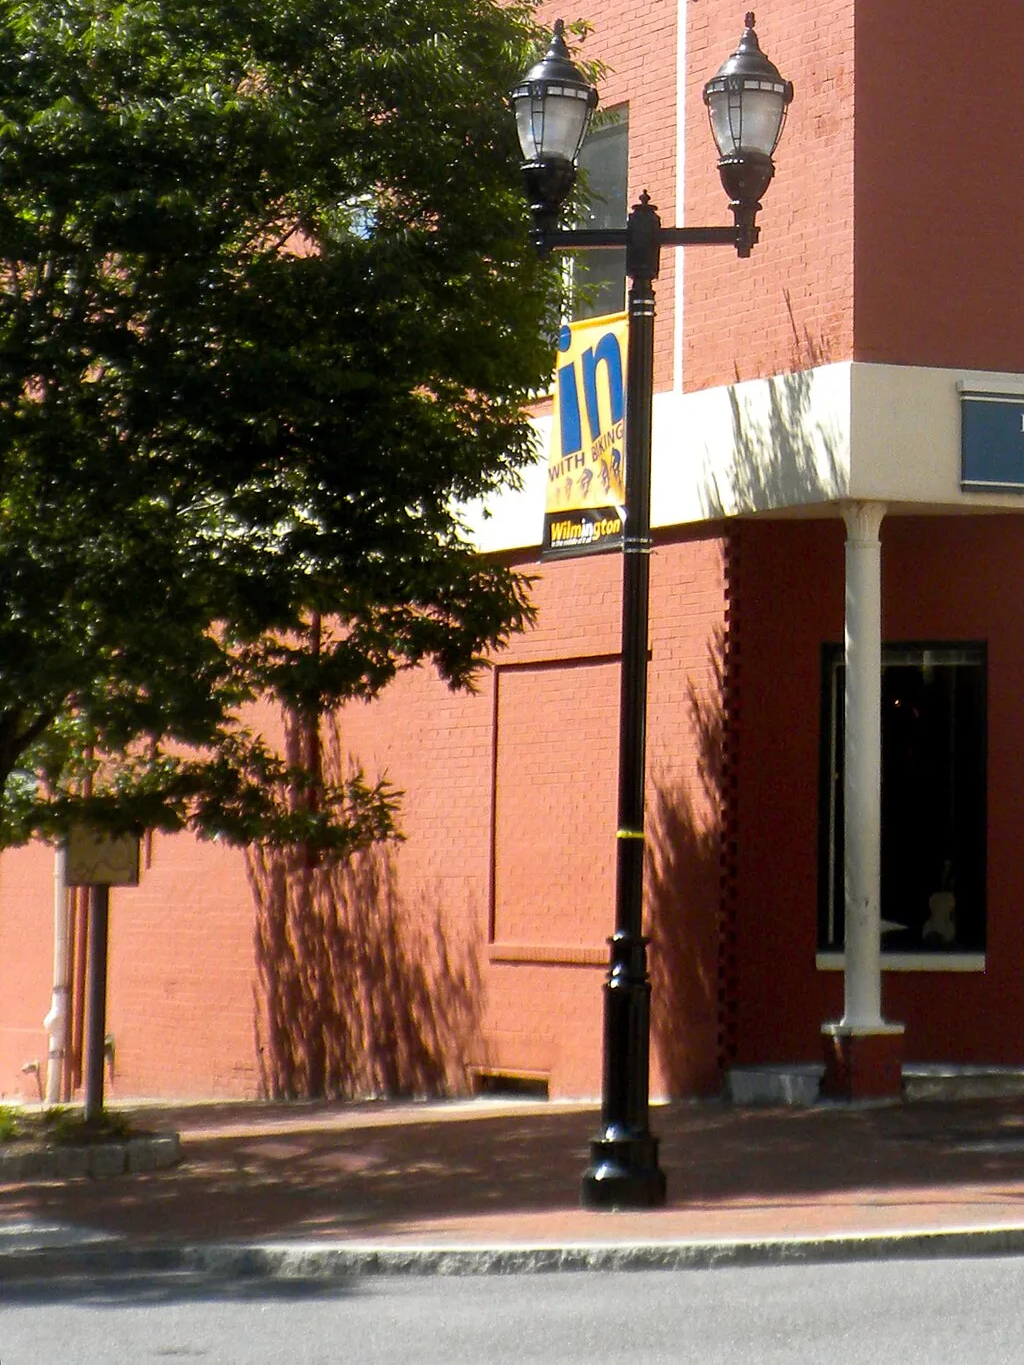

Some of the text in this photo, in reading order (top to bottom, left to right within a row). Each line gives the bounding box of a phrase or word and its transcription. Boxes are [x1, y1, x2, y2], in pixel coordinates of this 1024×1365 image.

[558, 324, 624, 456] in
[548, 422, 624, 482] WITH BIKING
[551, 517, 621, 541] Wilmington
